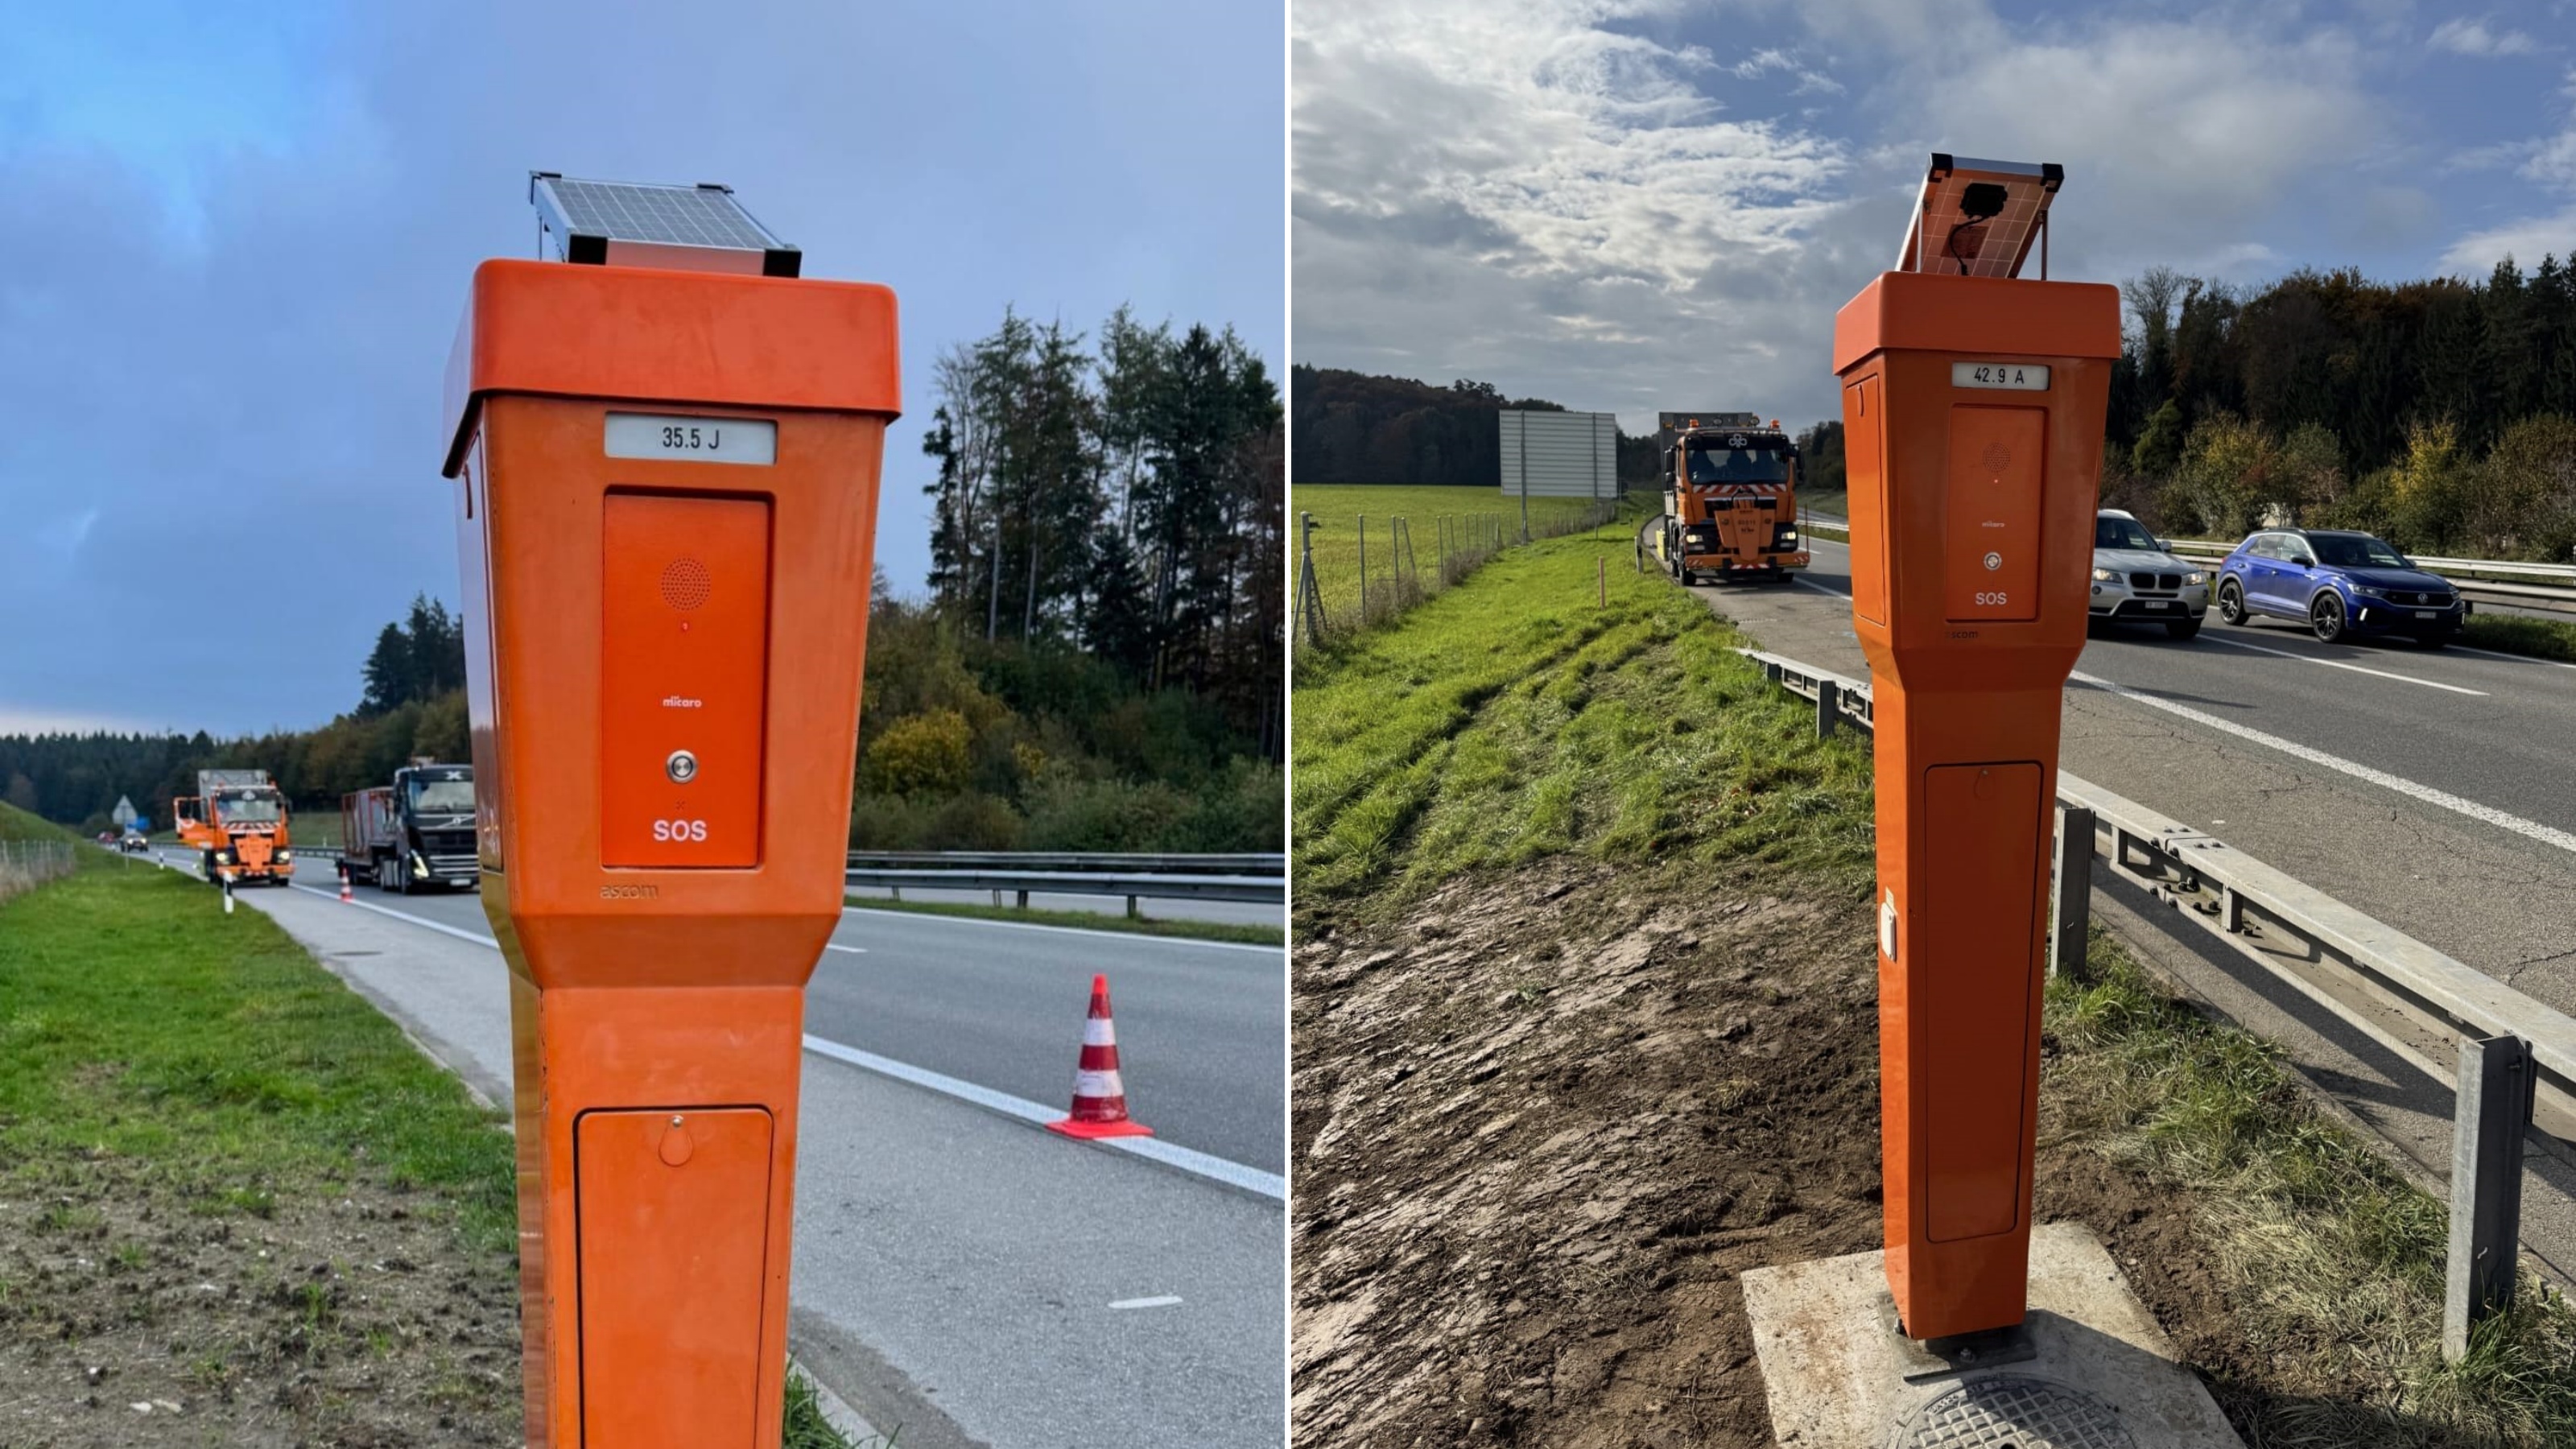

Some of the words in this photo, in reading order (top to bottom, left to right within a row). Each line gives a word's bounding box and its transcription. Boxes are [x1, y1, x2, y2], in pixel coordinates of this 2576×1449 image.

[1974, 367, 2005, 383] 42.9
[2015, 369, 2025, 385] A
[663, 427, 700, 448] 35.5
[708, 429, 720, 449] J
[1975, 592, 2007, 605] SOS
[653, 819, 708, 841] SOS
[601, 885, 658, 899] ascom
